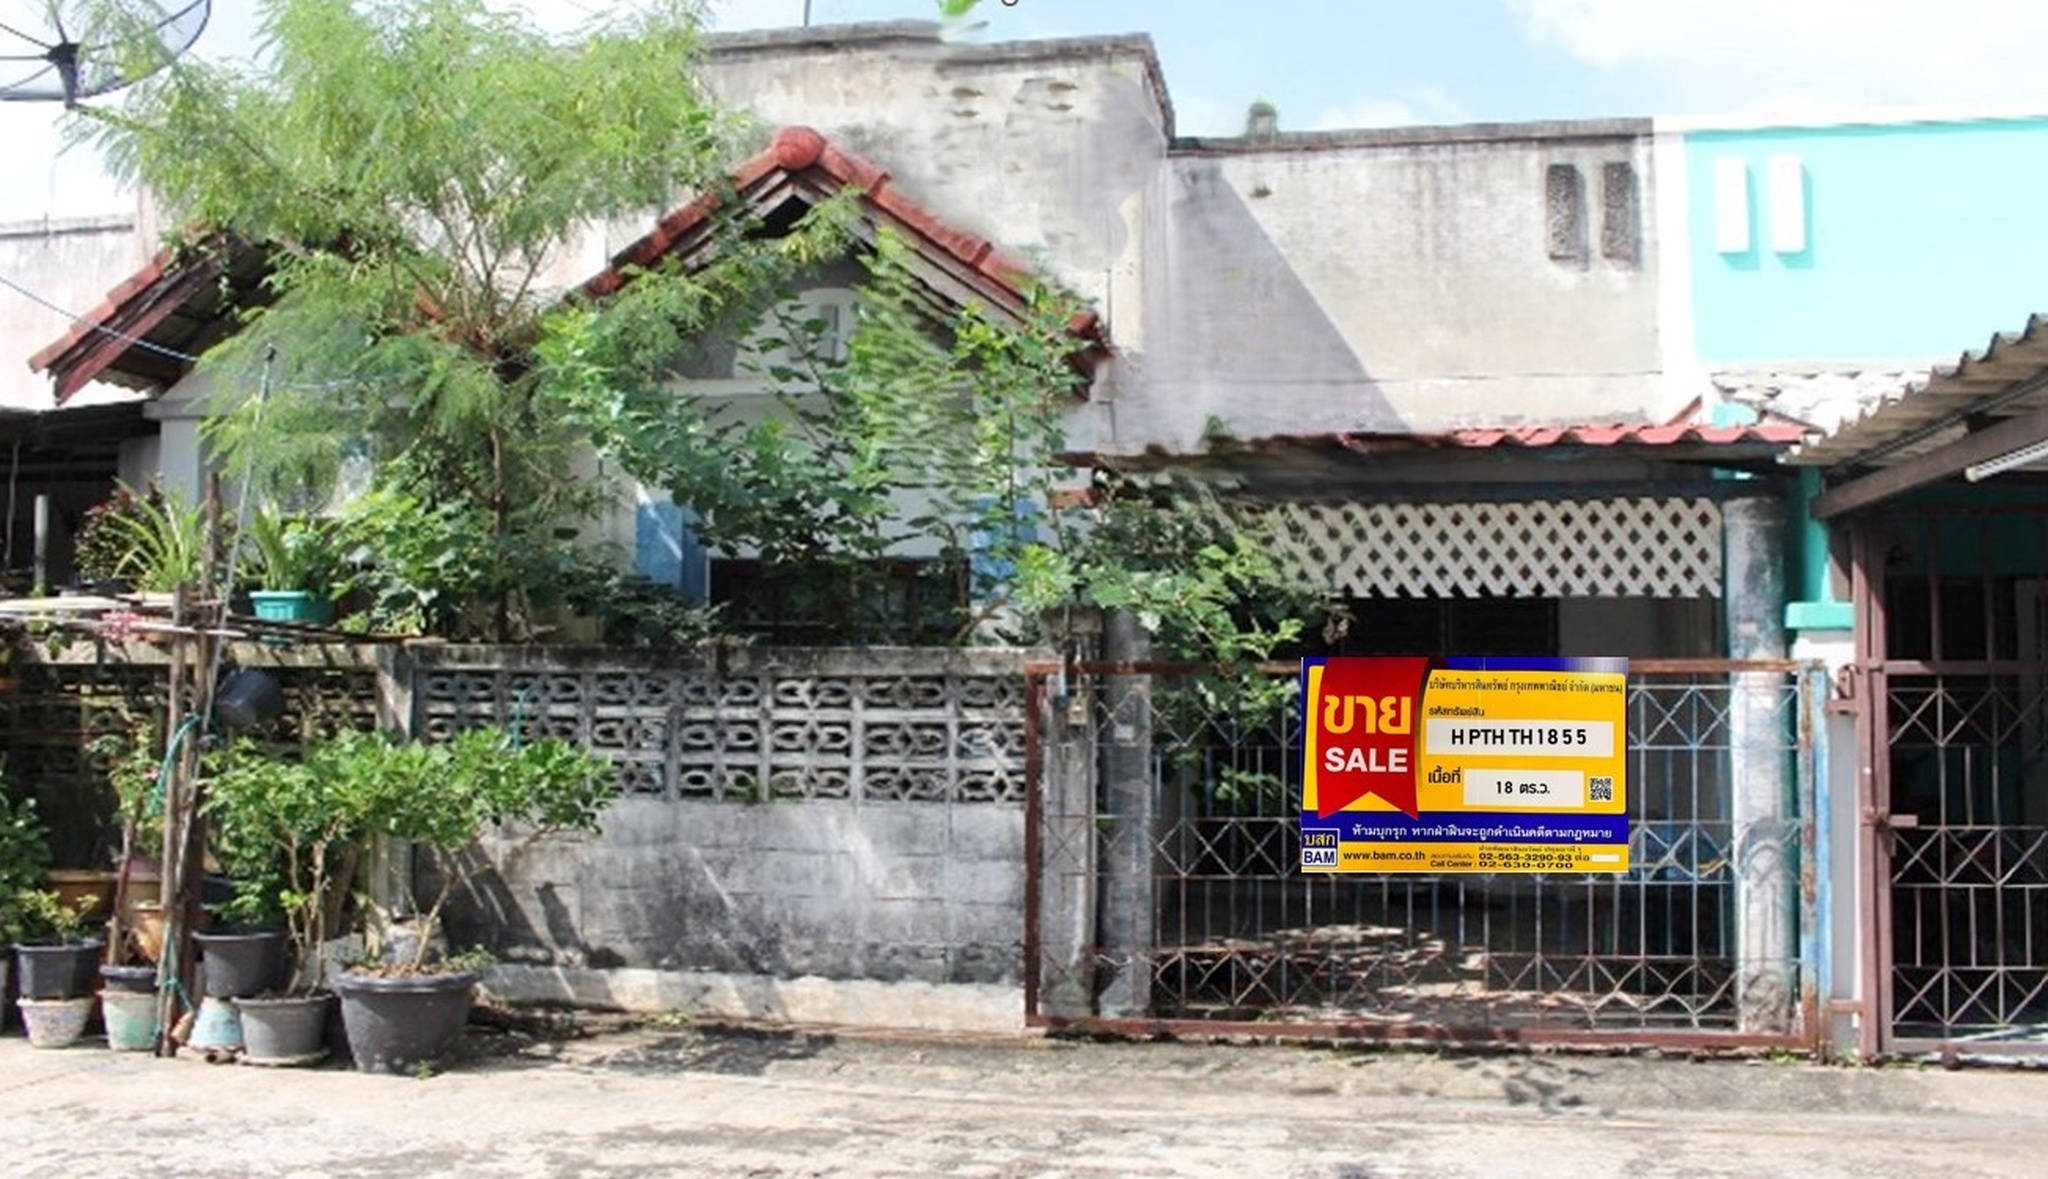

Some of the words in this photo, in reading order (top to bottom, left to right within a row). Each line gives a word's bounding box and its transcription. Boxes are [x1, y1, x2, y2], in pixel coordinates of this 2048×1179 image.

[1569, 680, 1590, 692] จำกัด
[1324, 695, 1411, 735] ขาย
[1324, 747, 1408, 773] SALE
[1428, 766, 1461, 784] เนื้อที่
[1496, 781, 1513, 794] 18
[1352, 824, 1407, 840] ห้ามบุกรุก
[1304, 833, 1335, 846] บสก
[1304, 851, 1335, 864] BAM
[1343, 851, 1426, 860] www.bam.co.th
[1479, 852, 1573, 861] 02-563-3290-93
[1446, 860, 1472, 868] Center
[1479, 861, 1573, 869] 02-630-0700
